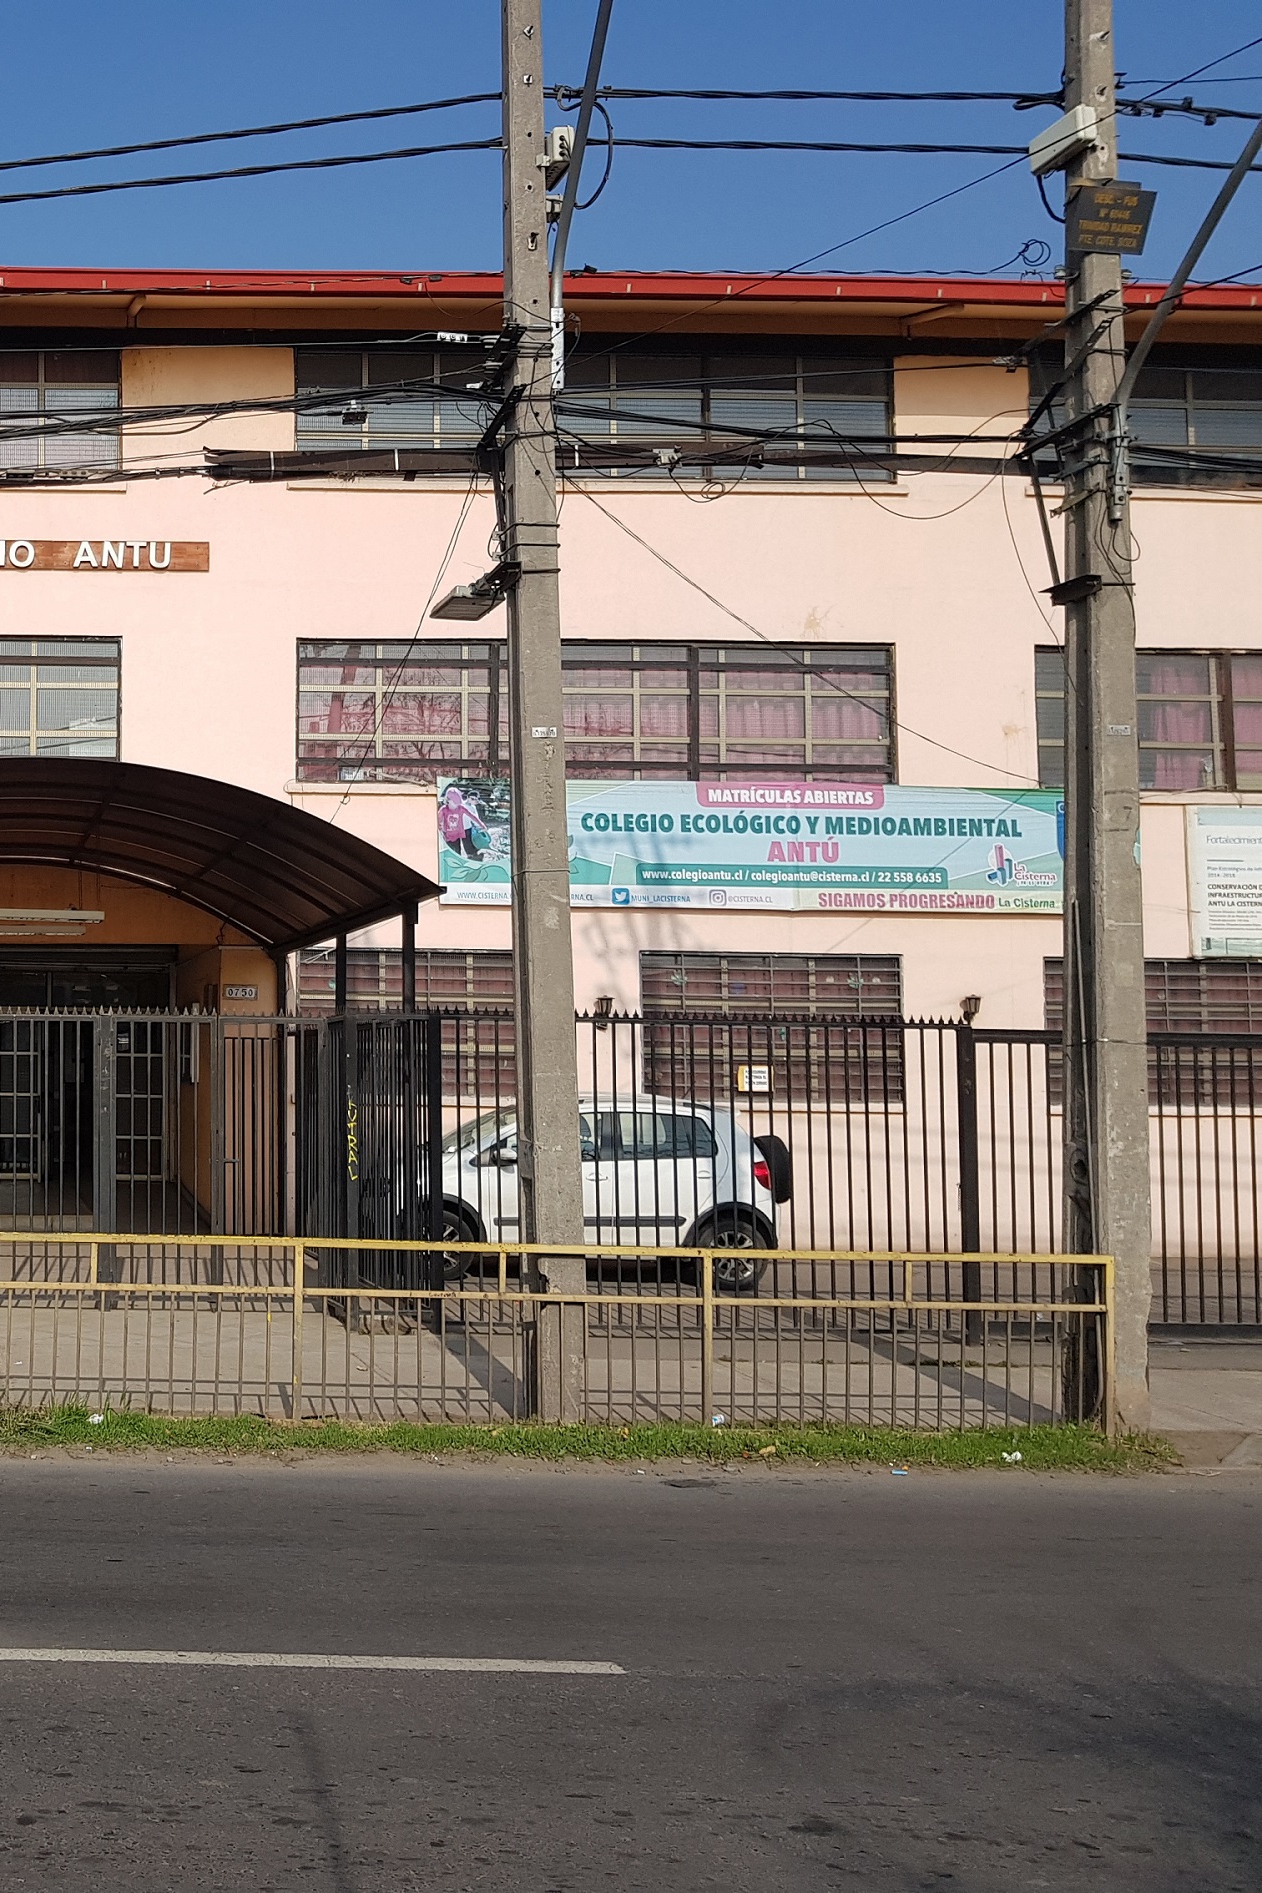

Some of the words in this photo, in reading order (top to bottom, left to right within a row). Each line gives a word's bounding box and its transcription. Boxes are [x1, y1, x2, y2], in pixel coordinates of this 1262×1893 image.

[72, 540, 172, 568] ANTU
[708, 785, 801, 804] MATRÍCULAS
[803, 789, 874, 805] ABIERTAS
[581, 812, 674, 833] COLEGIO
[680, 809, 801, 835] ECOLÓGICO
[805, 814, 820, 835] Y
[825, 816, 1023, 838] MEDIOAMBIENTAL
[767, 836, 840, 863] ANTÚ
[1013, 863, 1026, 872] La
[642, 869, 743, 882] www.colegioantu.cl
[751, 870, 870, 884] colegioantu@cisterna.cl
[878, 872, 892, 882] 22
[893, 872, 913, 883] 558
[915, 873, 942, 884] 6635
[1013, 871, 1056, 881] Cisterna
[1207, 883, 1258, 891] CONSERVACIÓN
[457, 891, 512, 900] WWW.CISTERNA.
[631, 894, 691, 904] MUNI_LACISTERNA
[818, 892, 886, 908] SIGAMOS
[890, 893, 995, 909] PROGRESANDO
[998, 897, 1010, 907] La
[1014, 898, 1055, 909] Cisterna
